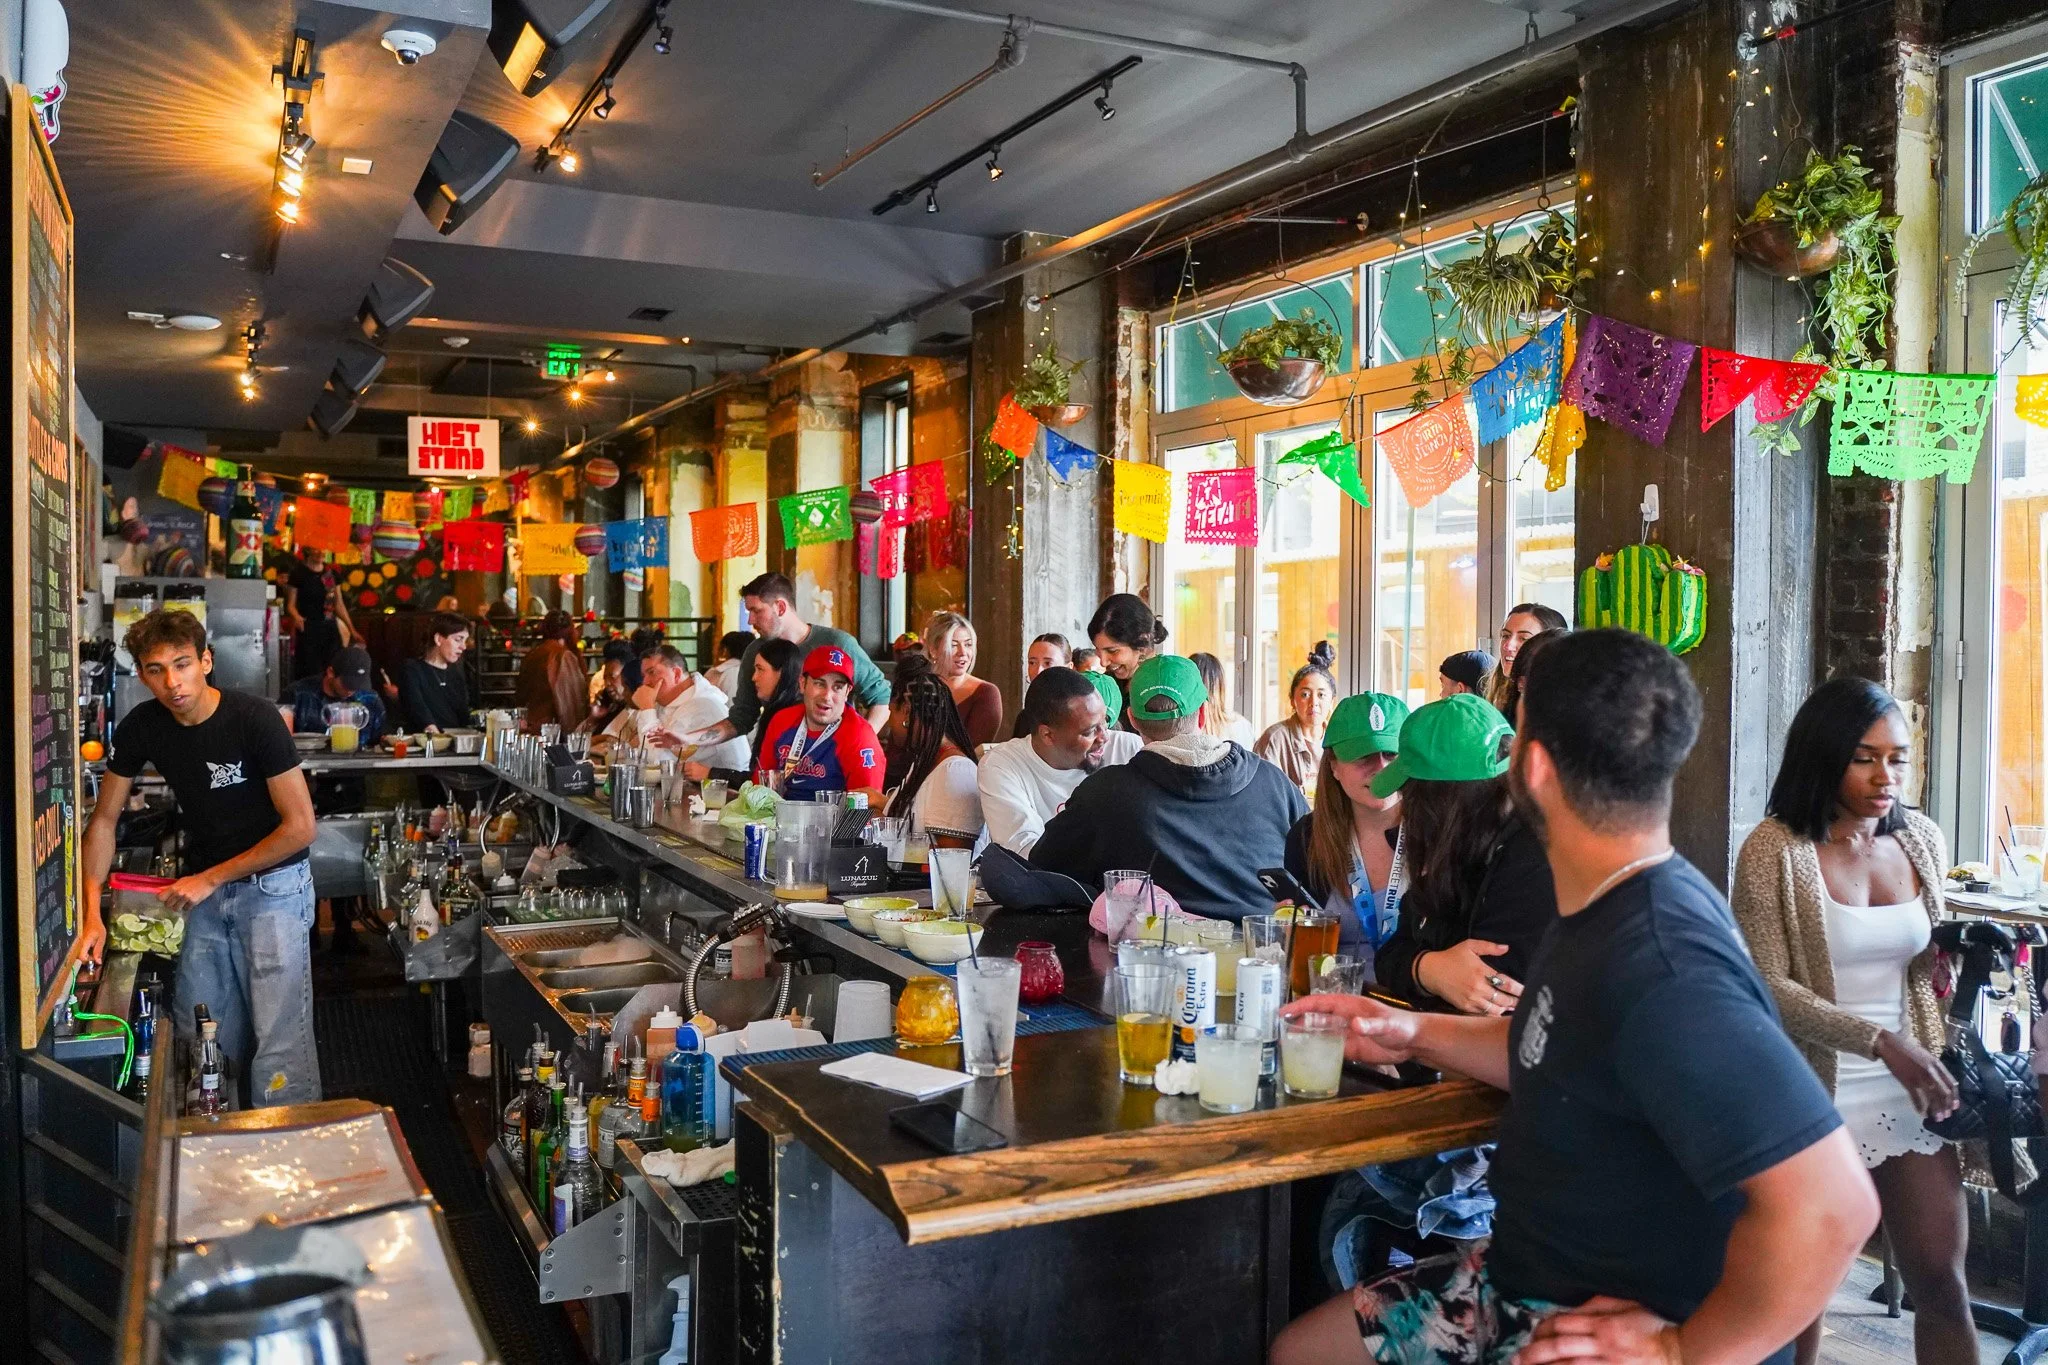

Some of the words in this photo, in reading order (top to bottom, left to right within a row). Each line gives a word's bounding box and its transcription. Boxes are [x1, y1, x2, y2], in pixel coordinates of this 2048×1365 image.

[422, 422, 480, 447] HOST
[52, 435, 68, 484] CANS
[418, 446, 484, 470] STAND
[35, 812, 46, 869] RED
[1182, 967, 1198, 1025] Corona
[1196, 981, 1207, 1013] Extra
